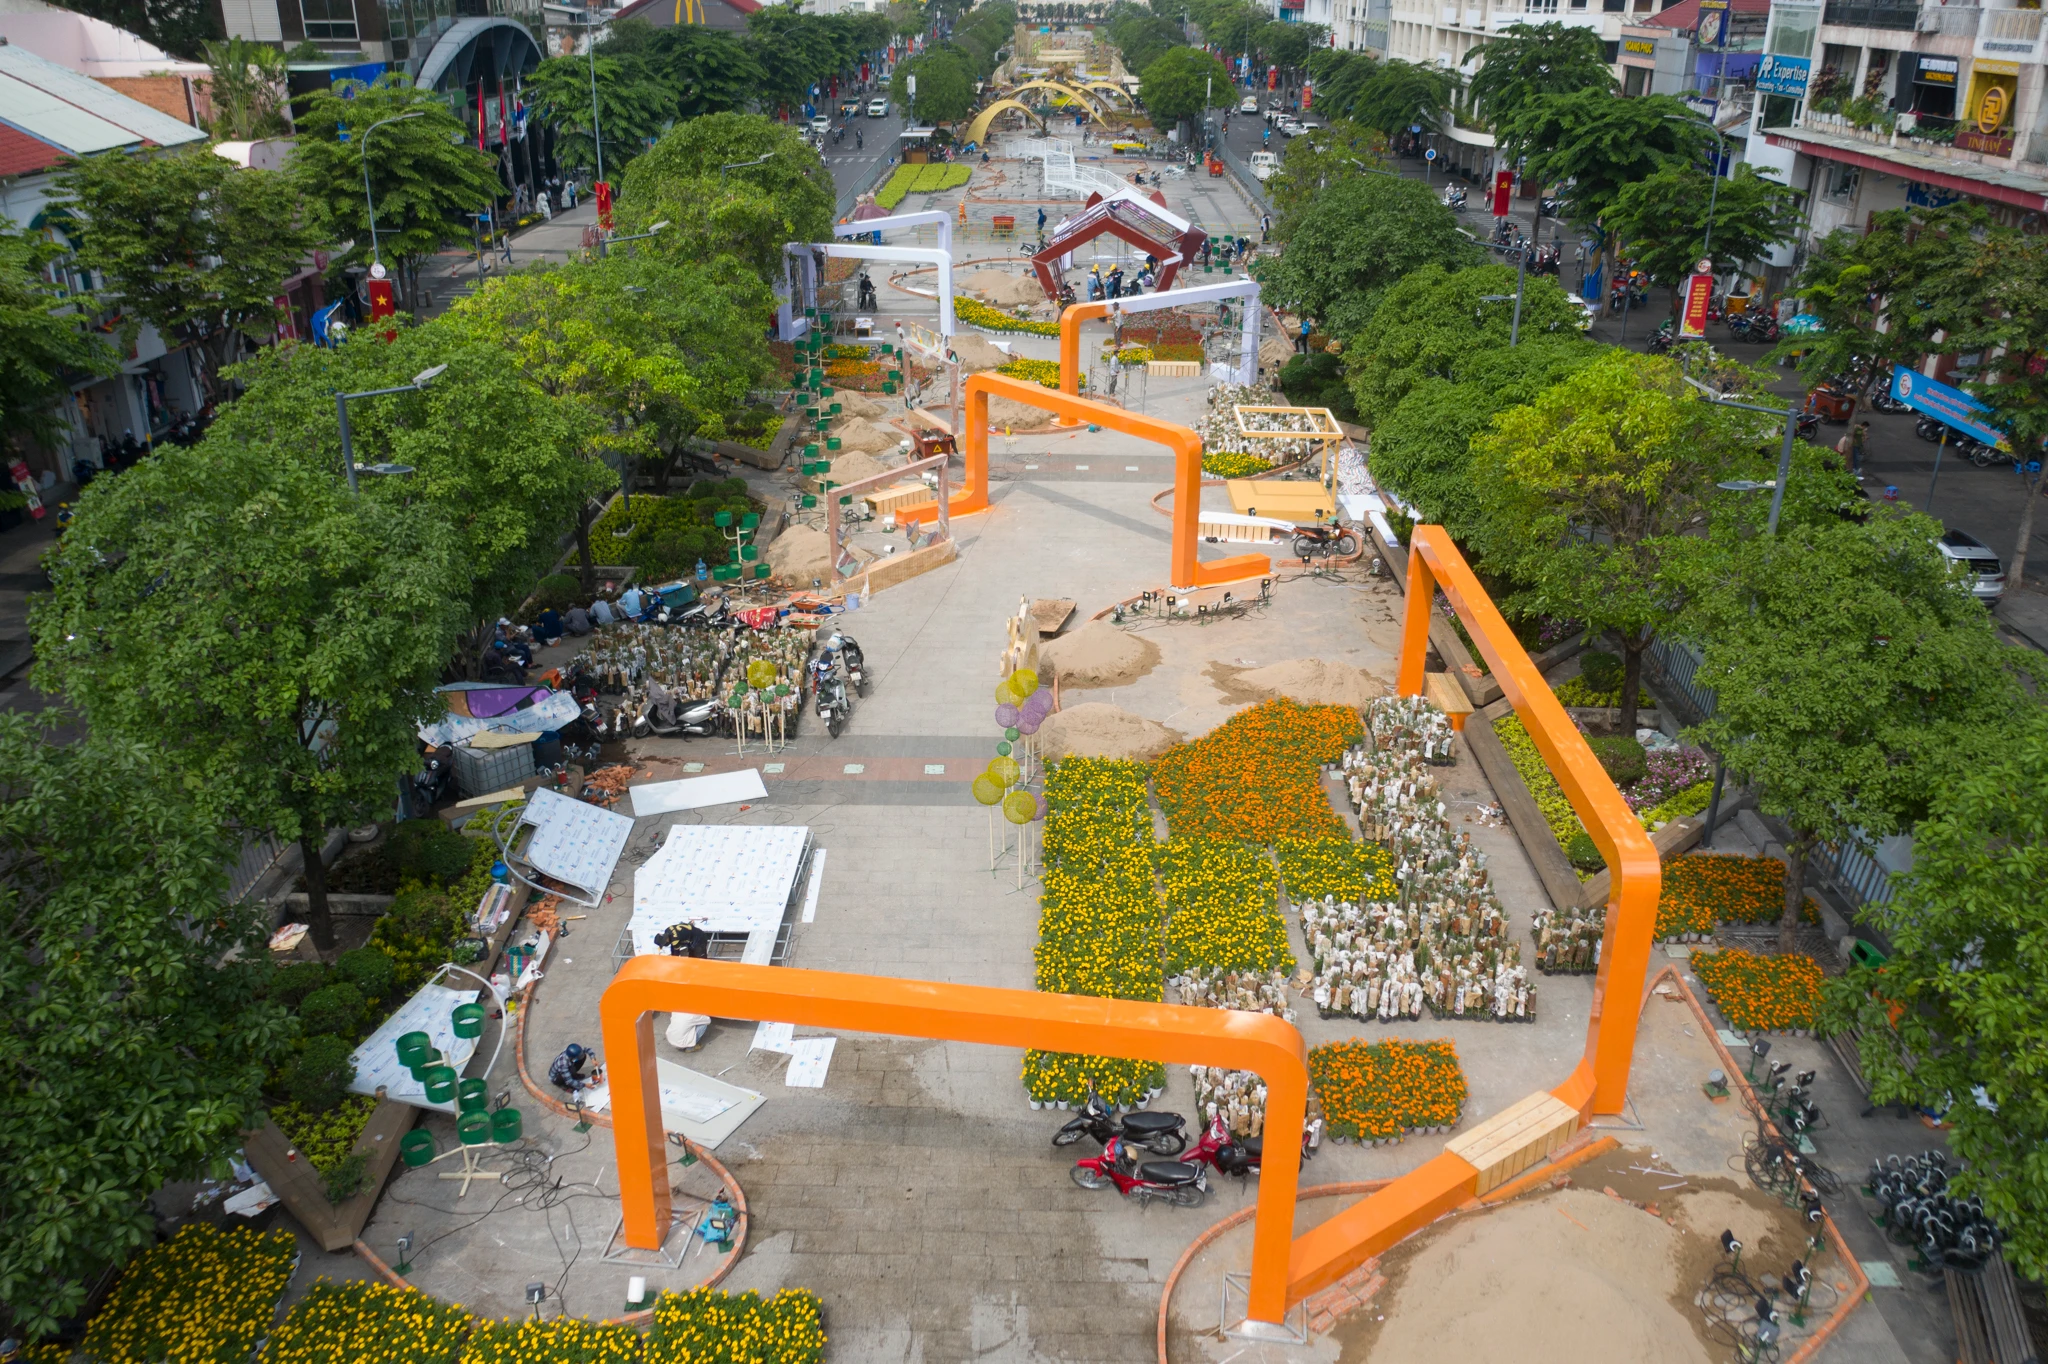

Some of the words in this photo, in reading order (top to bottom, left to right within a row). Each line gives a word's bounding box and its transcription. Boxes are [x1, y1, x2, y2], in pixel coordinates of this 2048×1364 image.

[1774, 62, 1808, 83] Expertise
[1756, 80, 1775, 92] Accounting
[1786, 84, 1805, 97] Consulting
